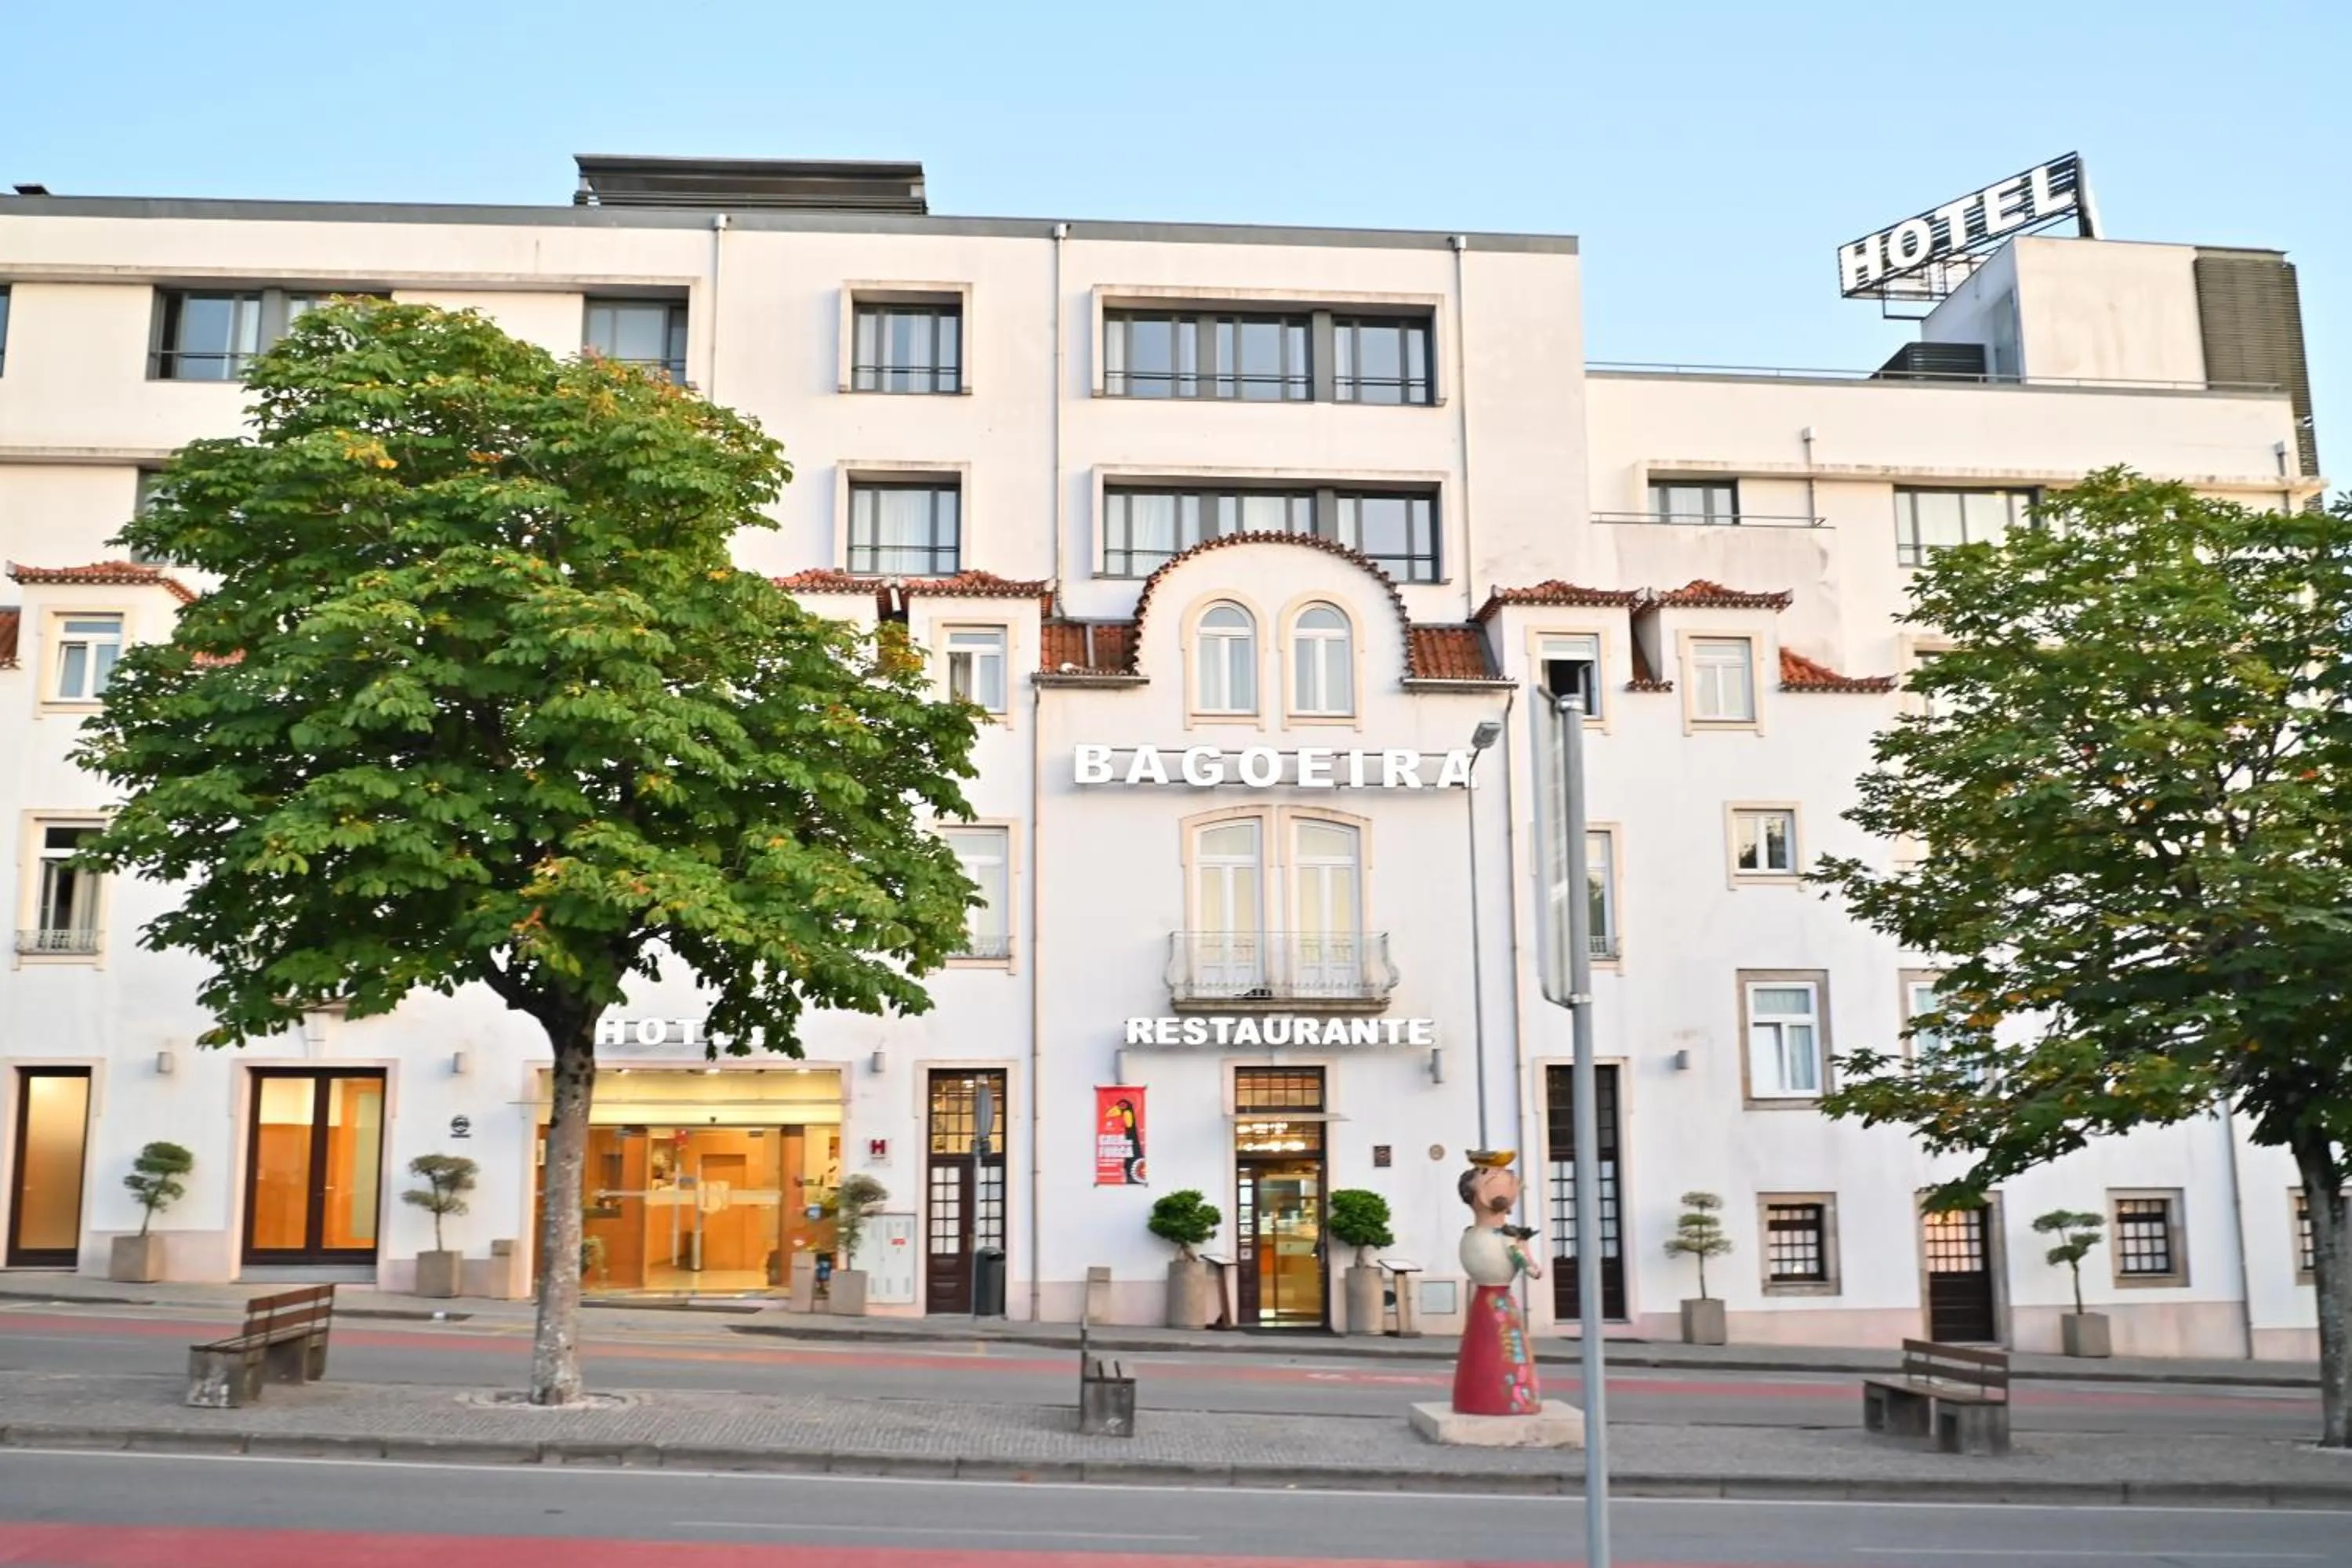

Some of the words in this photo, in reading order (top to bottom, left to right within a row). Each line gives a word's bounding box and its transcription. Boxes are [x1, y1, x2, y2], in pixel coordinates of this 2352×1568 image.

[1839, 165, 2074, 291] HOTEL
[1075, 744, 1479, 789] BAGOEIRA
[1127, 1017, 1434, 1045] RESTAURANTE
[870, 1139, 886, 1154] H
